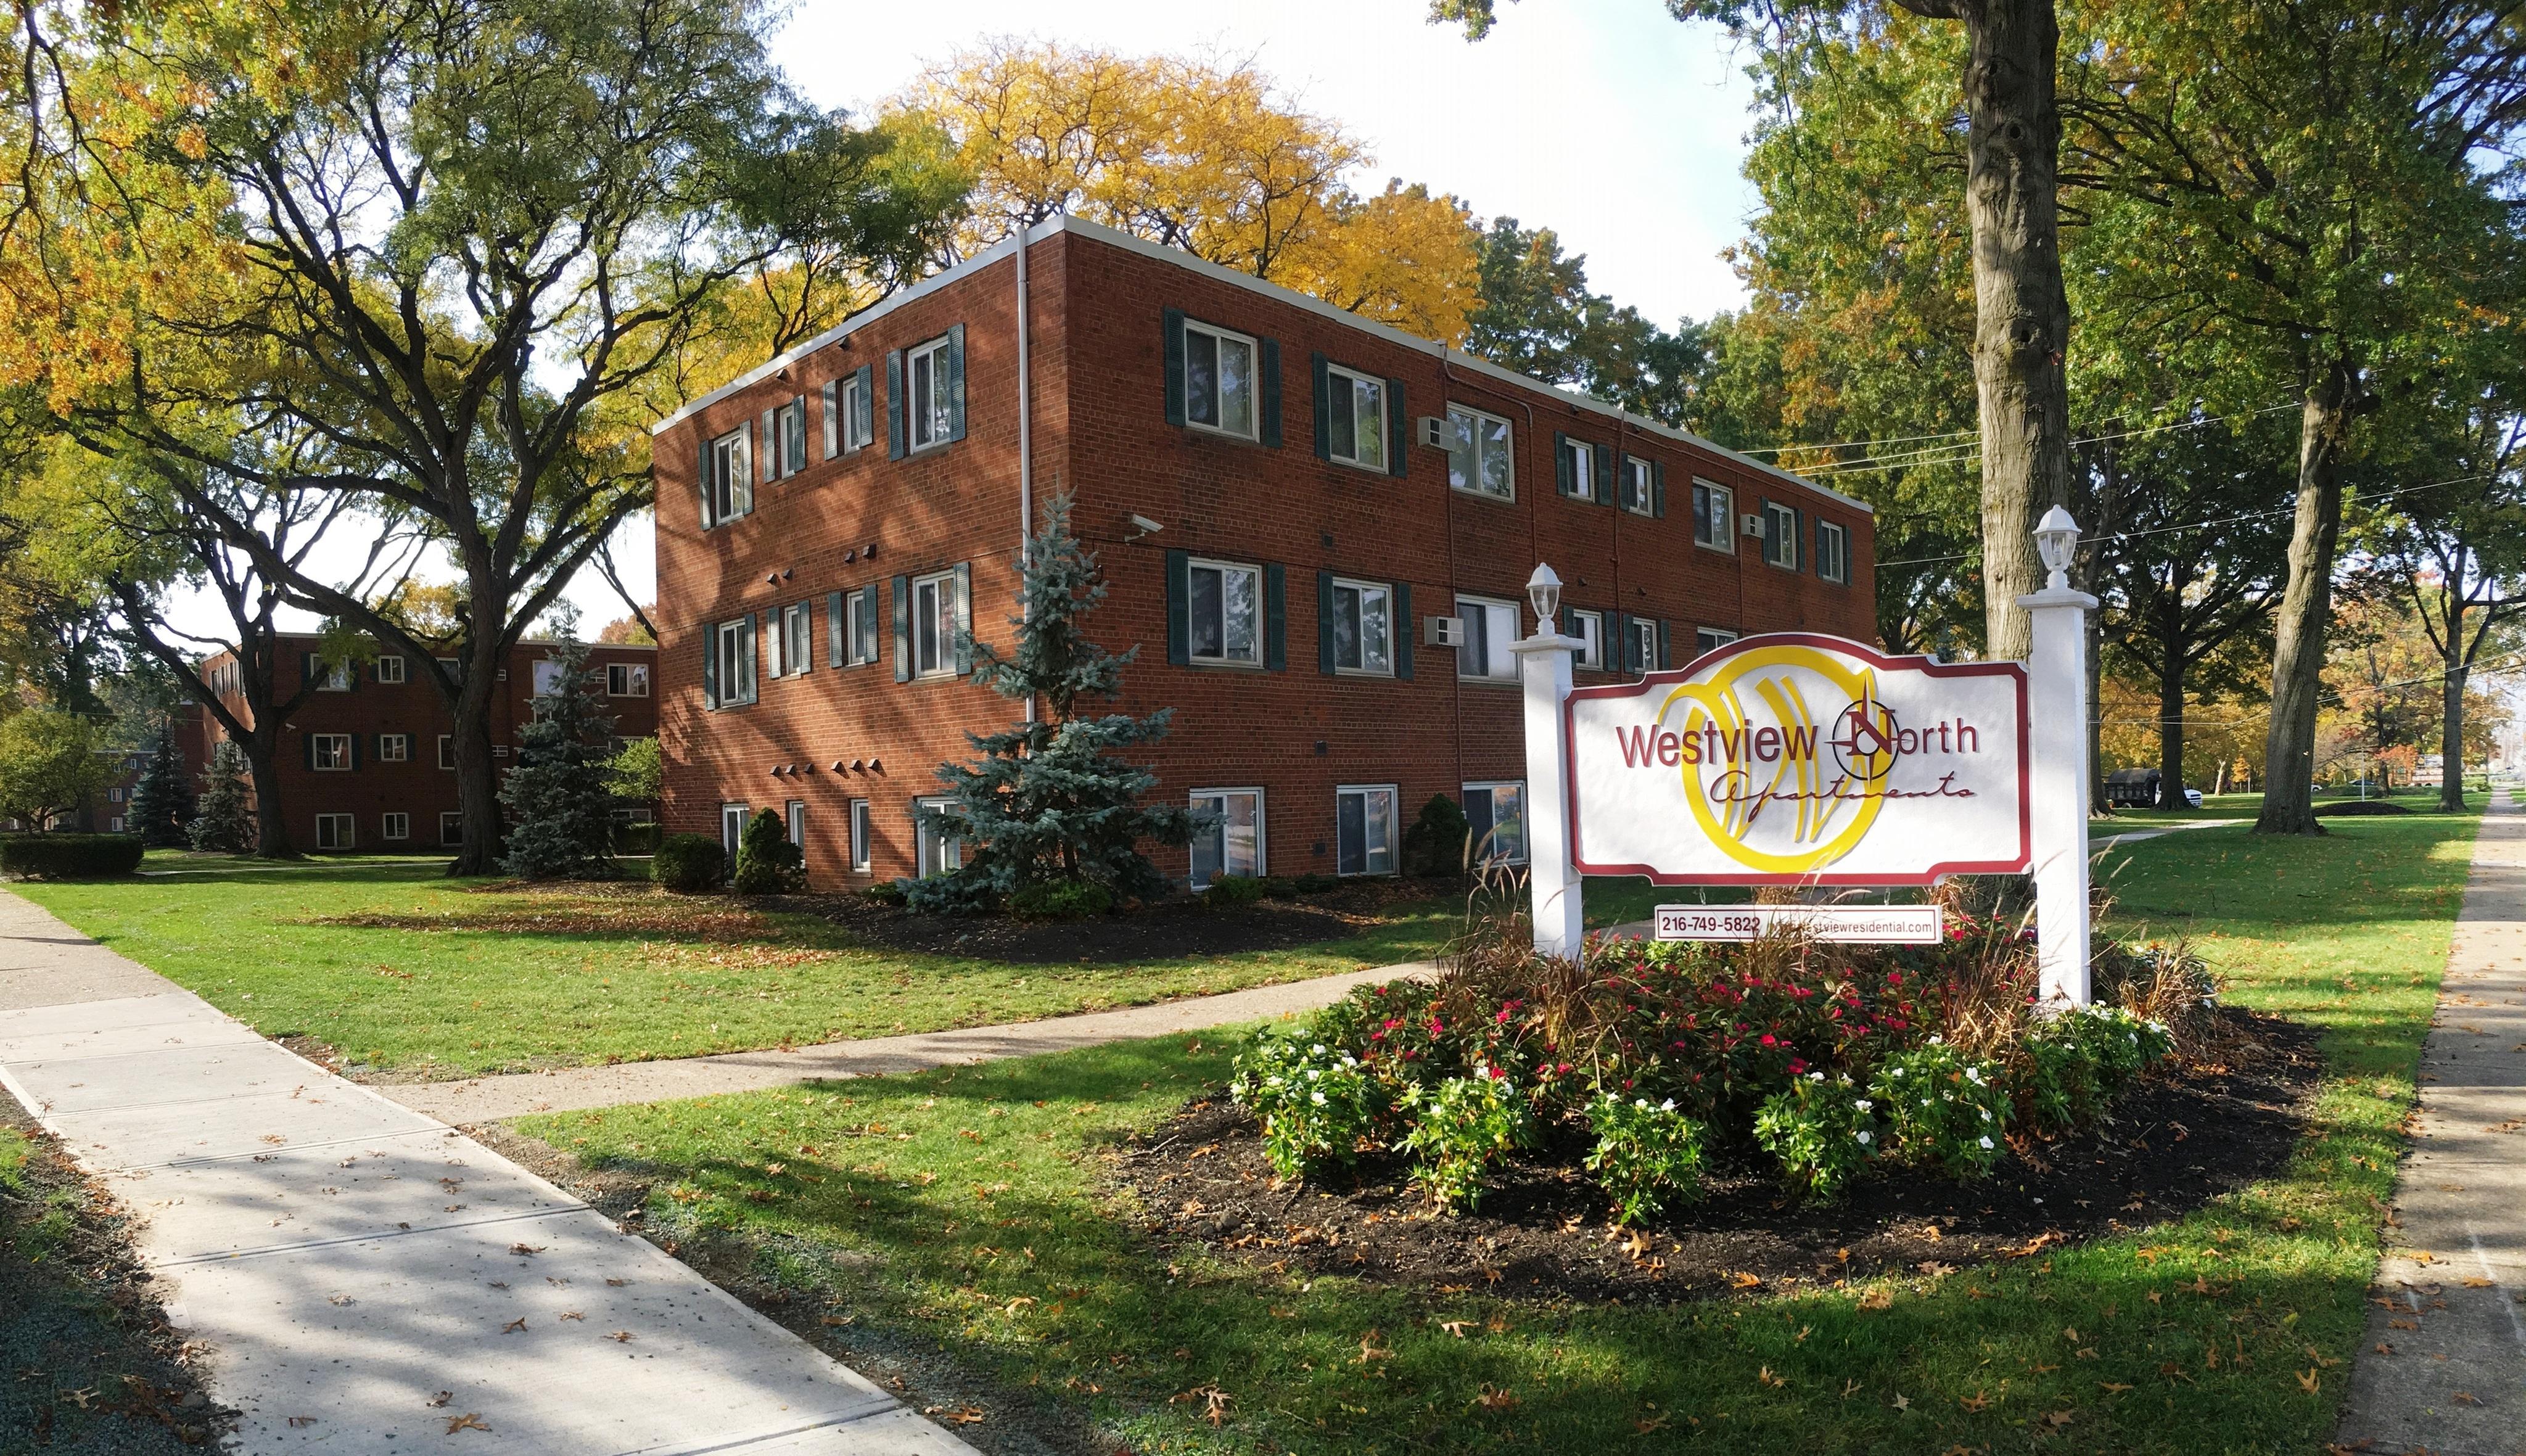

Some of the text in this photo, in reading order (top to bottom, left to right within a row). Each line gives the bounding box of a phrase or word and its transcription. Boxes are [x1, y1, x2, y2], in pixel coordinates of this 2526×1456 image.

[1616, 709, 1977, 768] Westview North
[1709, 770, 1975, 823] Apartments
[1662, 916, 1760, 931] 216-749-5822
